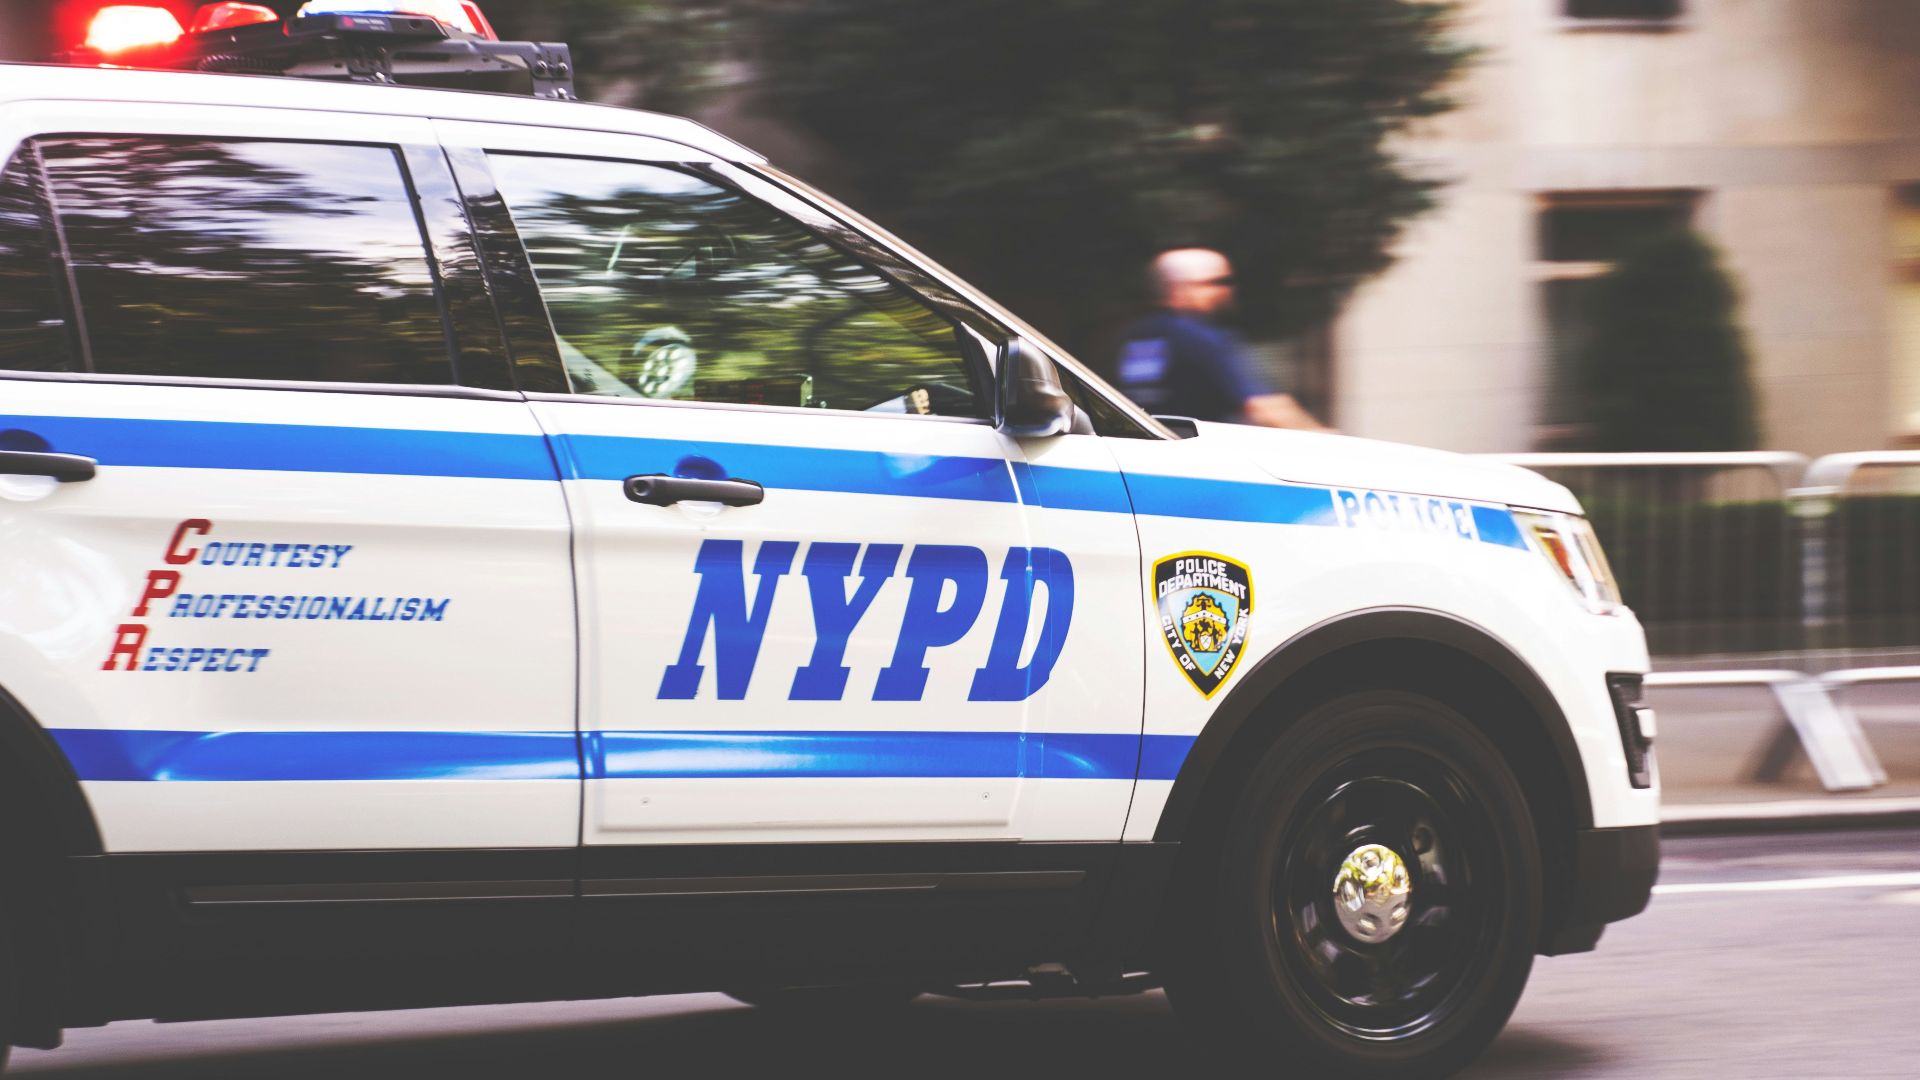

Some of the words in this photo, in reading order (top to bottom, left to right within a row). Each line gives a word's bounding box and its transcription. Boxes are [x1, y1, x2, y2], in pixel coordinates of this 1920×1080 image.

[1158, 573, 1246, 599] DEPARTMENT
[1175, 558, 1227, 577] POLICE
[656, 539, 1075, 702] NYPD
[1161, 615, 1181, 649] CITY
[1179, 653, 1196, 672] OF
[1214, 649, 1236, 680] NEW
[1232, 608, 1249, 644] YORK
